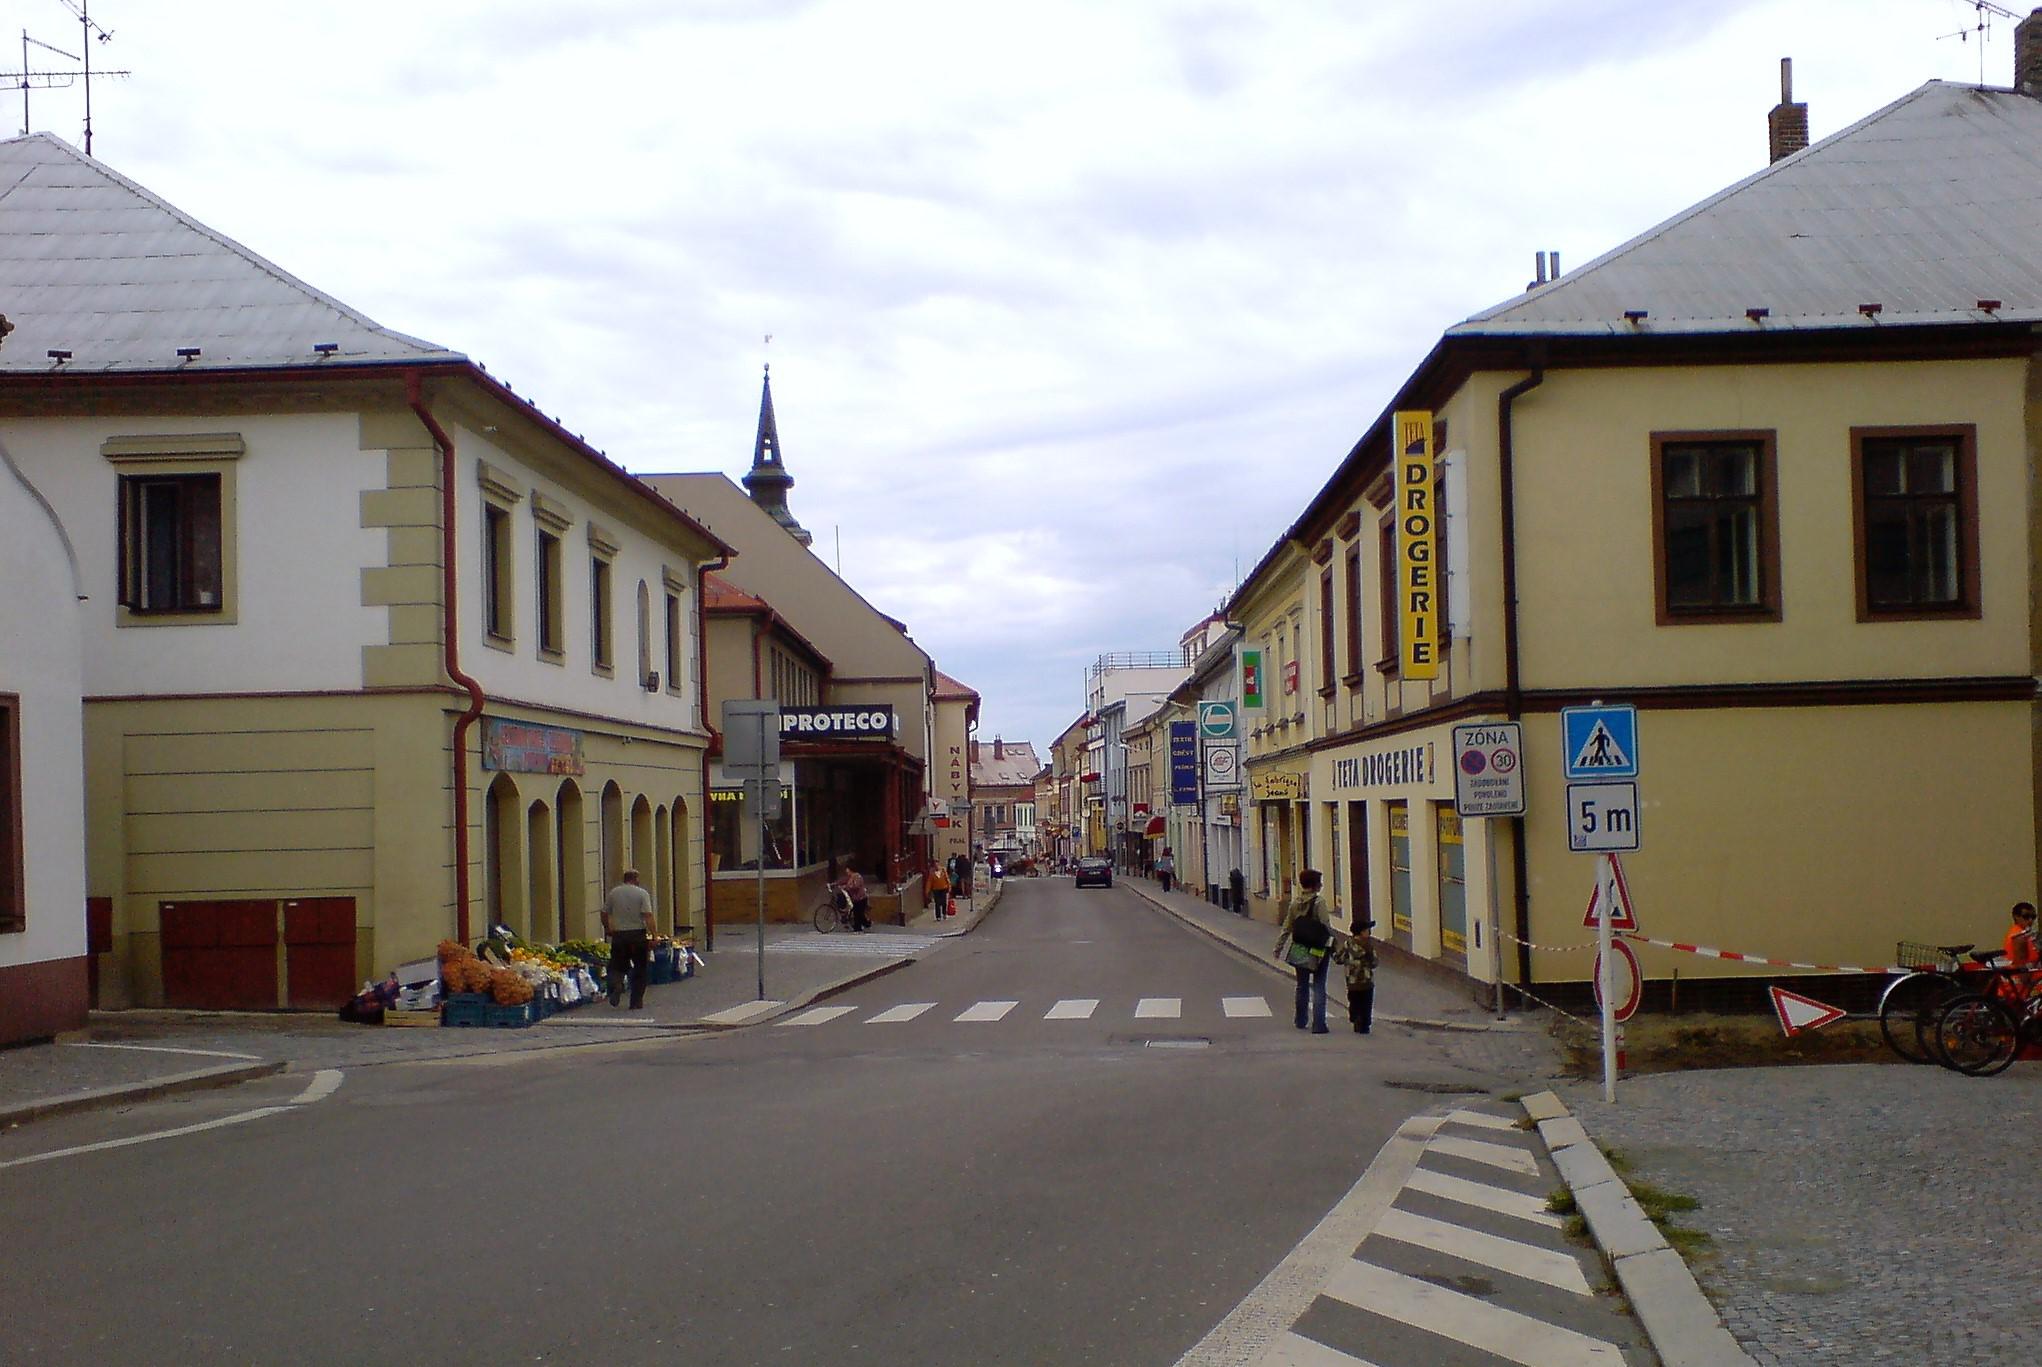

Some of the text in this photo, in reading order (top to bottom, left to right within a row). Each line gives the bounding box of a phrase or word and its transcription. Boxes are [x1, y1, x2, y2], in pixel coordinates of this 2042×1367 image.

[1404, 463, 1431, 665] DROGERIE
[1465, 728, 1509, 746] ZÓNA
[1336, 757, 1359, 788] TETA
[1362, 747, 1424, 786] DROGERIE
[1495, 754, 1512, 767] 30
[1581, 801, 1632, 833] 5 m
